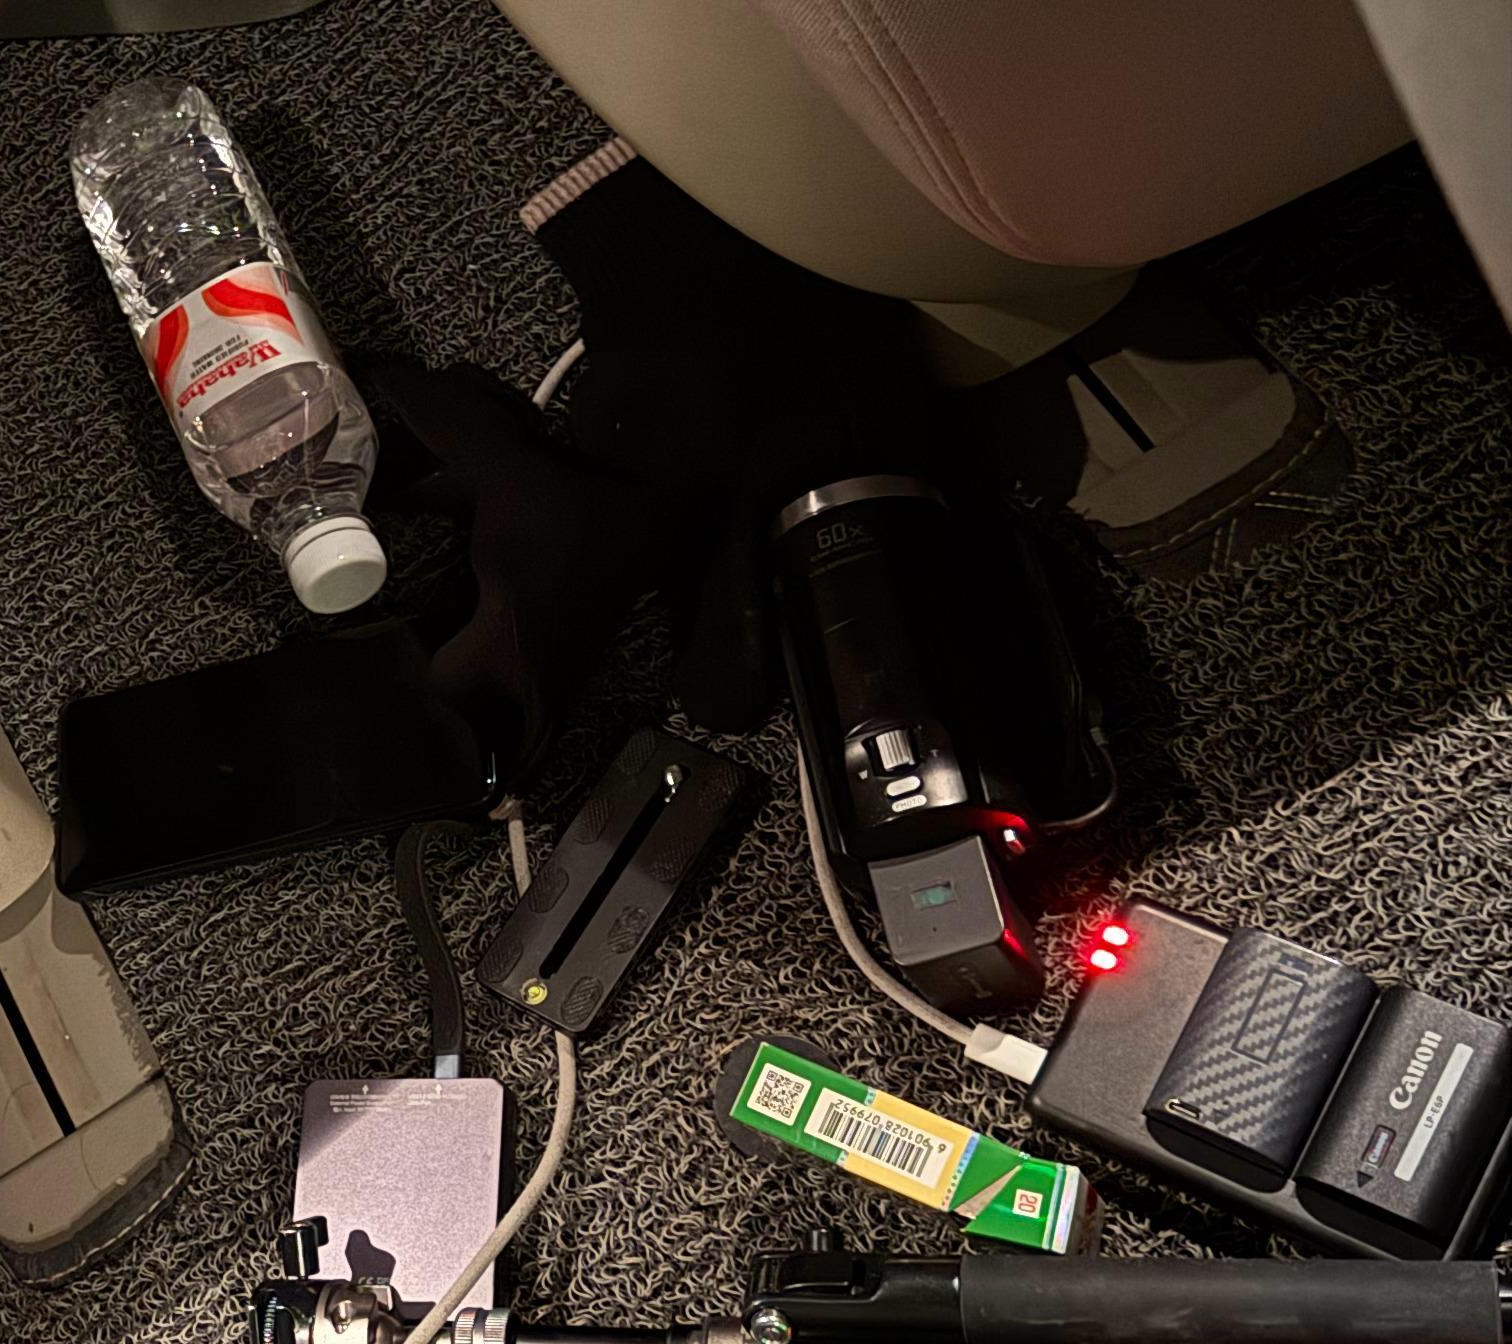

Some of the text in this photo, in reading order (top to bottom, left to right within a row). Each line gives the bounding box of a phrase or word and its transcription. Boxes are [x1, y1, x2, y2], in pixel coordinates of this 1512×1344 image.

[176, 340, 281, 408] Wahaha
[1388, 1029, 1443, 1111] Canon
[834, 1099, 881, 1125] 079952
[1423, 1094, 1446, 1129] LP-E6P
[886, 1121, 932, 1147] 901028
[1018, 1194, 1038, 1213] 20
